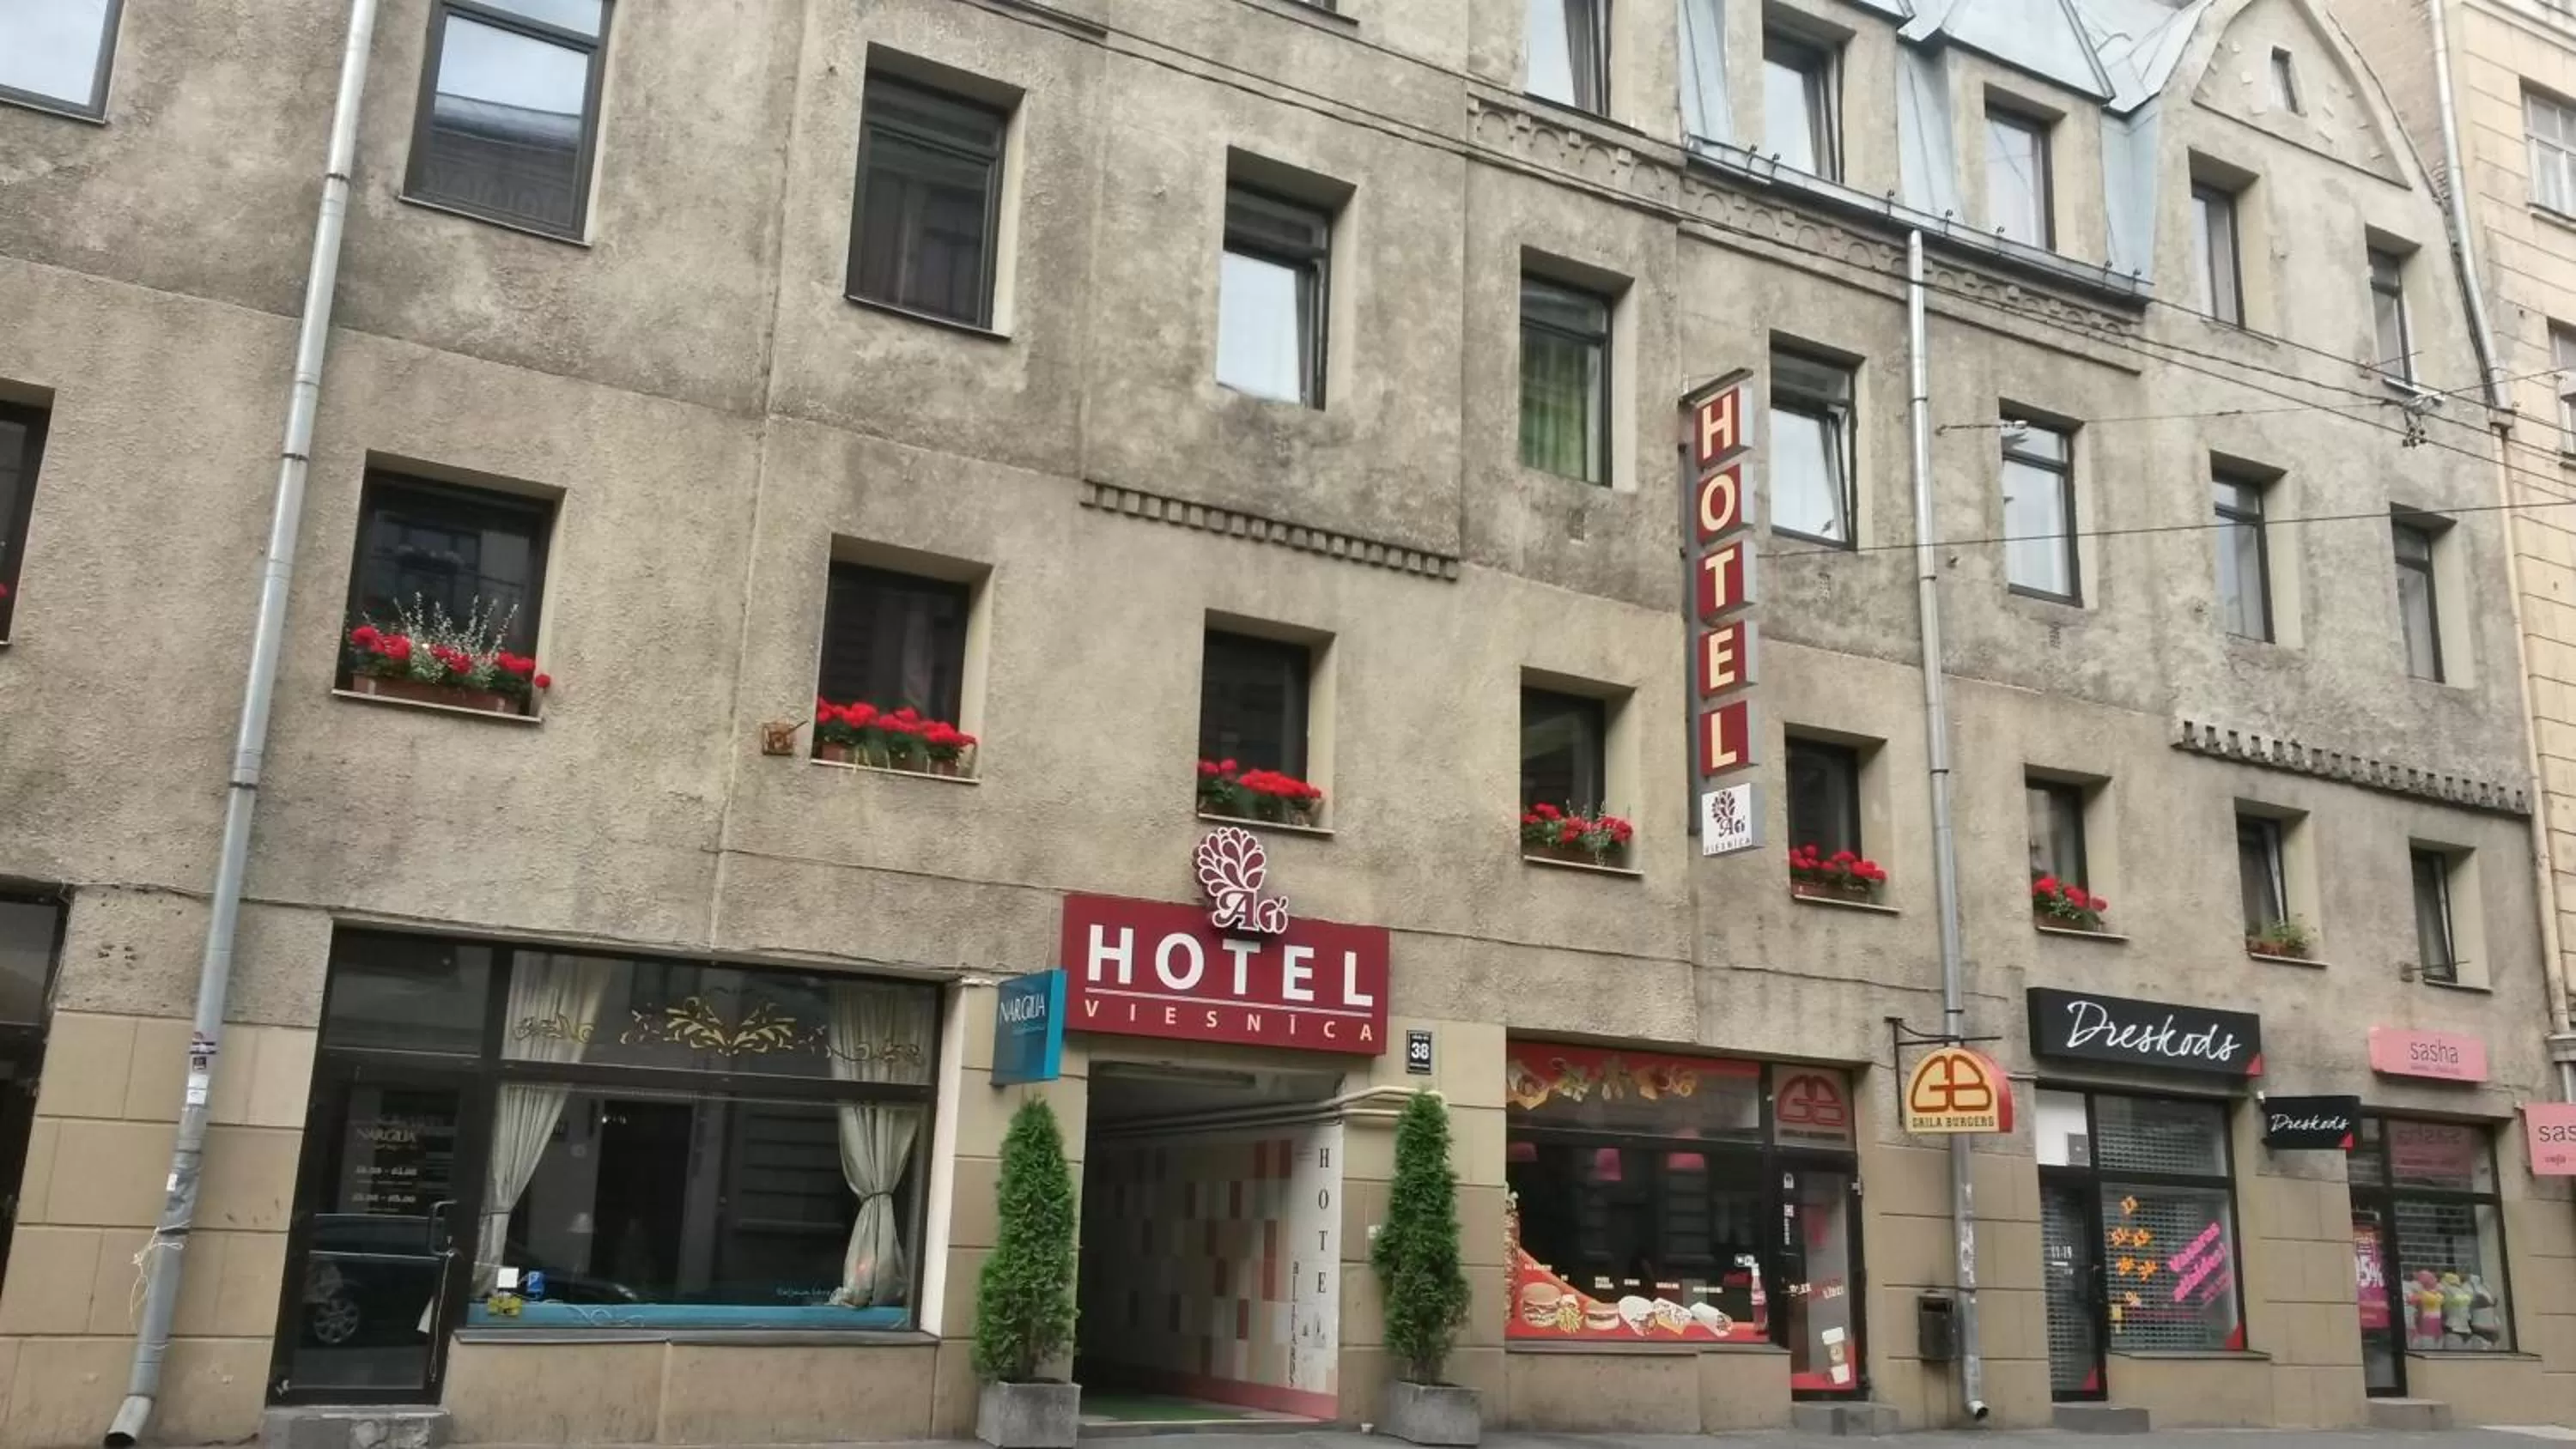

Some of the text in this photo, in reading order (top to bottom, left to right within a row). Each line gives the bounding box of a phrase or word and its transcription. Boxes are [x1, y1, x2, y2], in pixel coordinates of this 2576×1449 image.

[1700, 398, 1737, 770] HOTEL
[1087, 924, 1374, 1008] HOTEL
[1084, 999, 1373, 1042] VIESNĪCA
[2067, 1000, 2242, 1062] Dreskods
[1411, 1041, 1430, 1060] 38
[2409, 1037, 2459, 1064] sasha
[1912, 1116, 1995, 1128] GRILA BURGERS
[2270, 1113, 2350, 1132] Dreskods
[2538, 1125, 2576, 1143] sas
